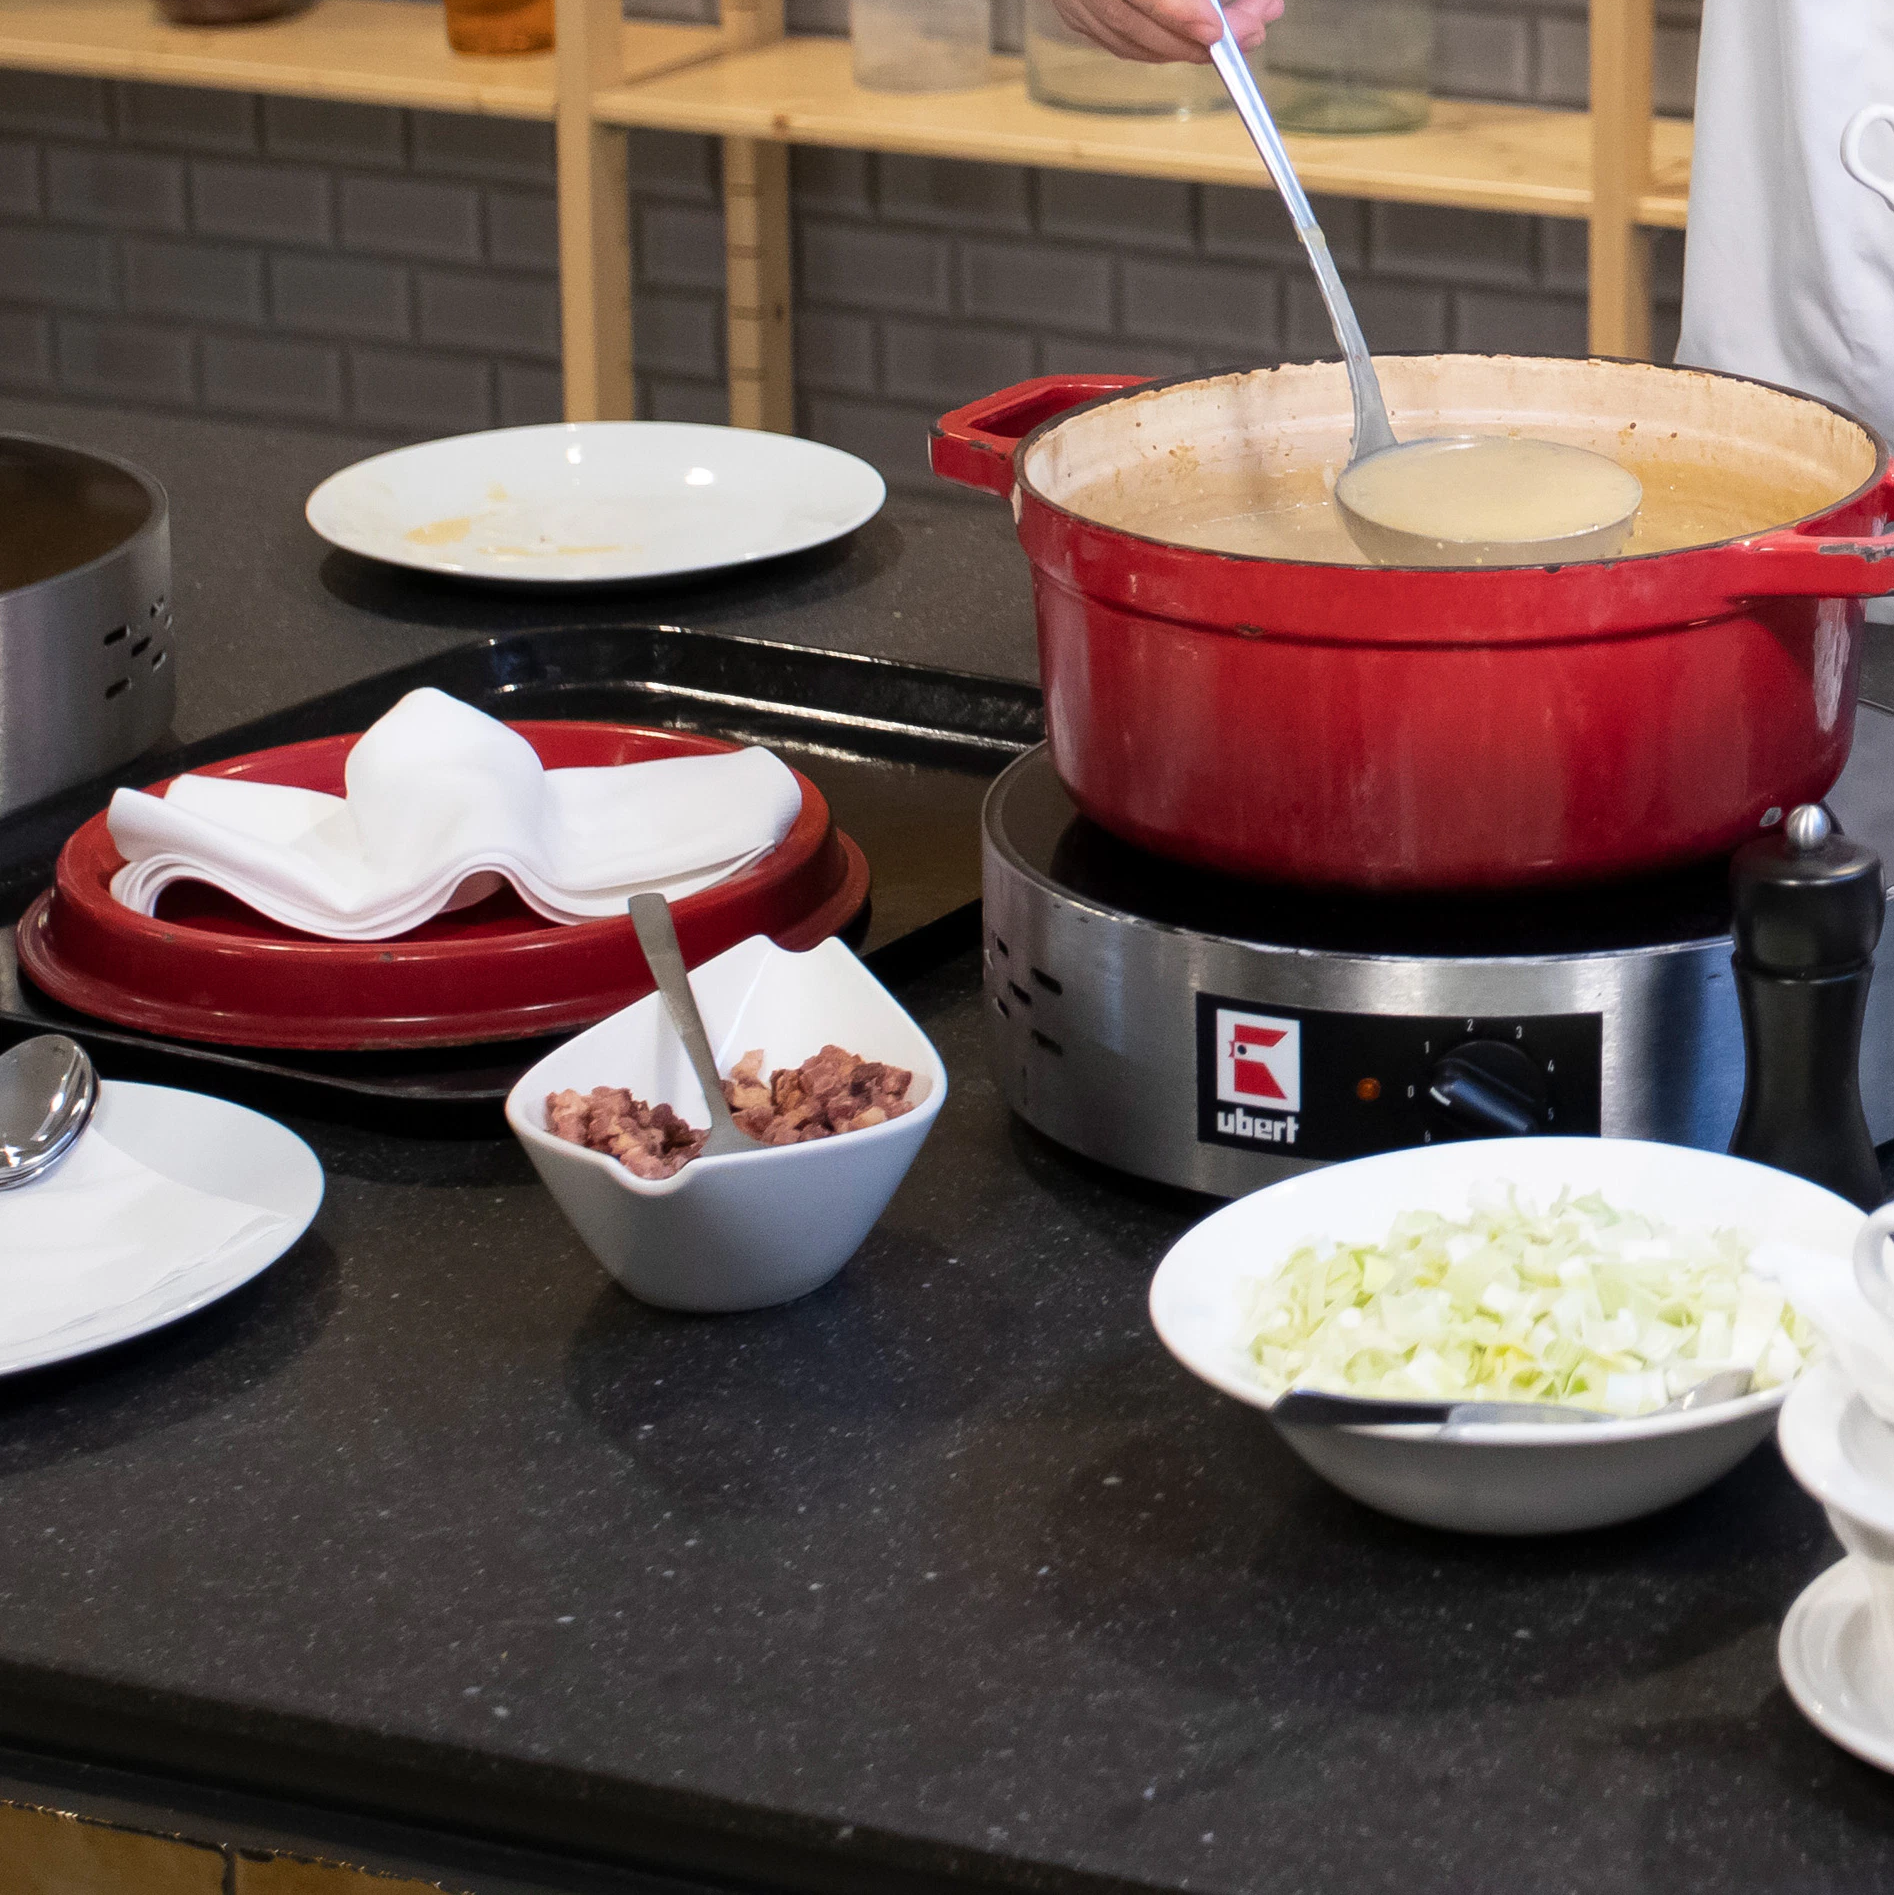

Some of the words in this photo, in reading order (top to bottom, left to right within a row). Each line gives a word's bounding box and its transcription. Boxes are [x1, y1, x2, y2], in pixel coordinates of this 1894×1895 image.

[1466, 1019, 1474, 1032] 2
[1515, 1025, 1523, 1039] 3
[1424, 1041, 1430, 1054] 1
[1547, 1059, 1555, 1073] 4
[1547, 1107, 1554, 1121] 5
[1217, 1108, 1300, 1144] ubert
